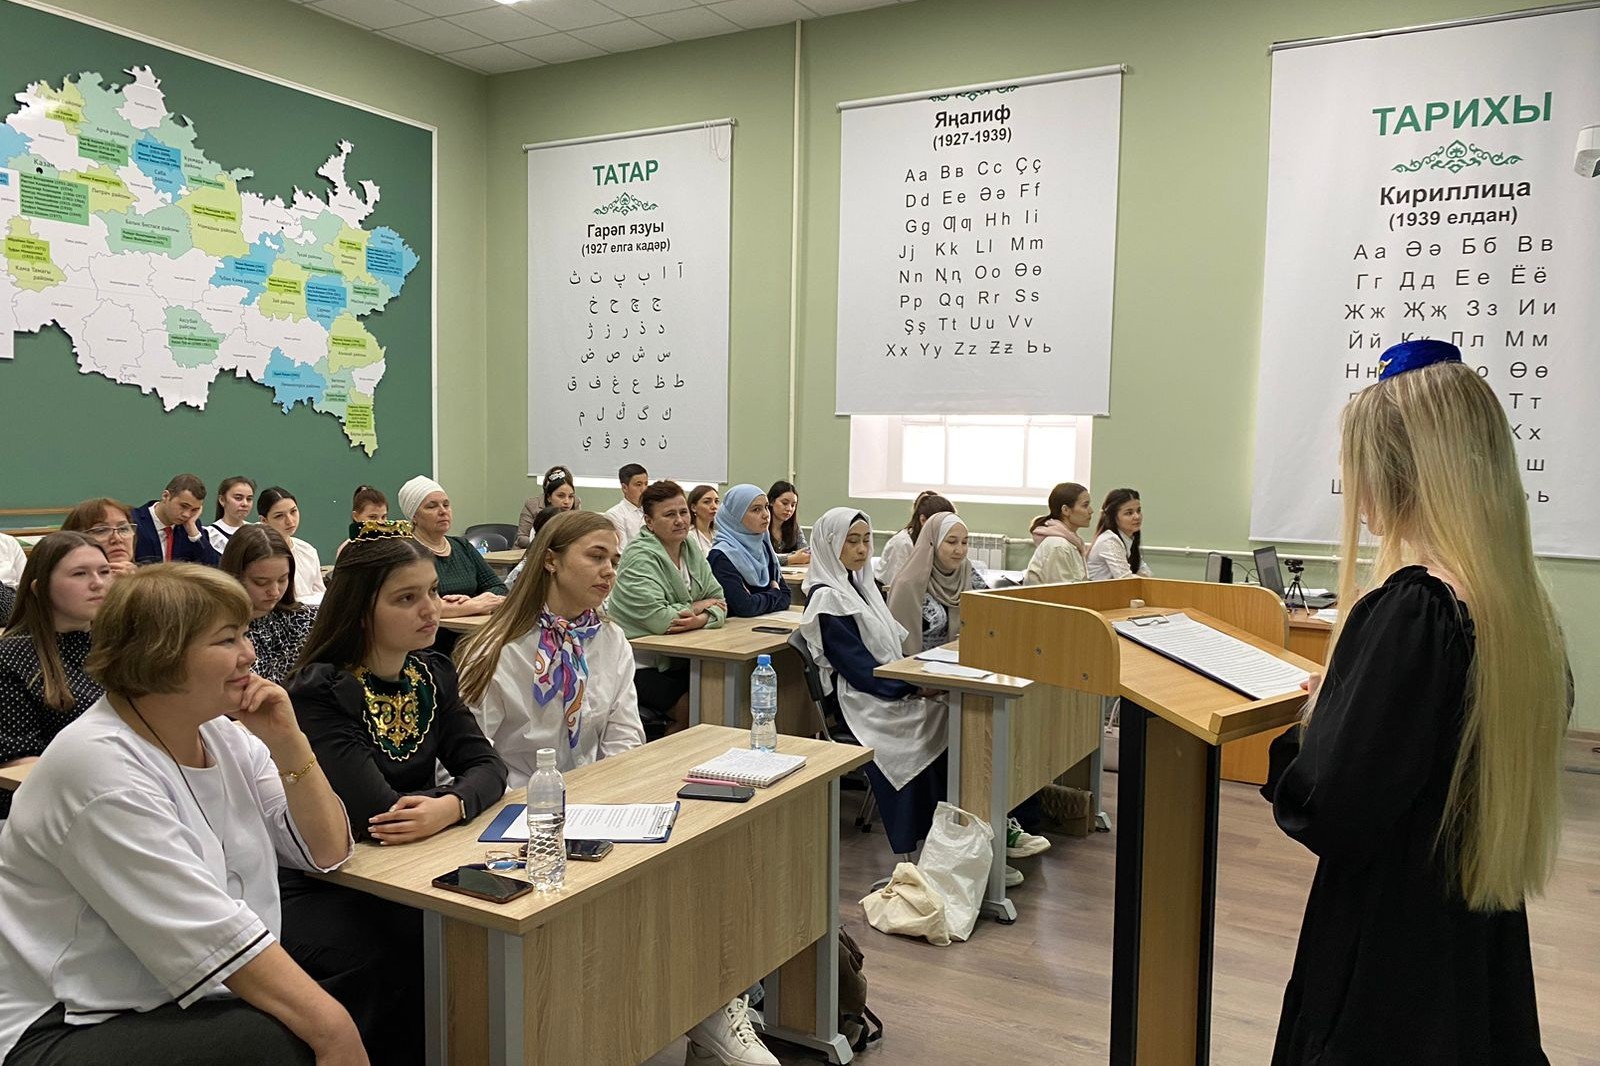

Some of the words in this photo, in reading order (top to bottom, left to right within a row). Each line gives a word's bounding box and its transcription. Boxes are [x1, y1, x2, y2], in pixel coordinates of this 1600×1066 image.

[935, 104, 1011, 129] Яңалиф
[1371, 91, 1553, 136] ТАРИХЫ
[933, 126, 1012, 151] (1927-1939)
[593, 160, 659, 186] ТАТАР
[1380, 181, 1531, 206] Кириллица
[588, 223, 626, 241] Гарәп
[630, 221, 665, 238] язуы
[1388, 211, 1442, 232] (1939
[1457, 206, 1518, 226] елдан)
[582, 243, 609, 258] (1927
[611, 243, 634, 255] елга
[636, 238, 671, 255] кадәр)
